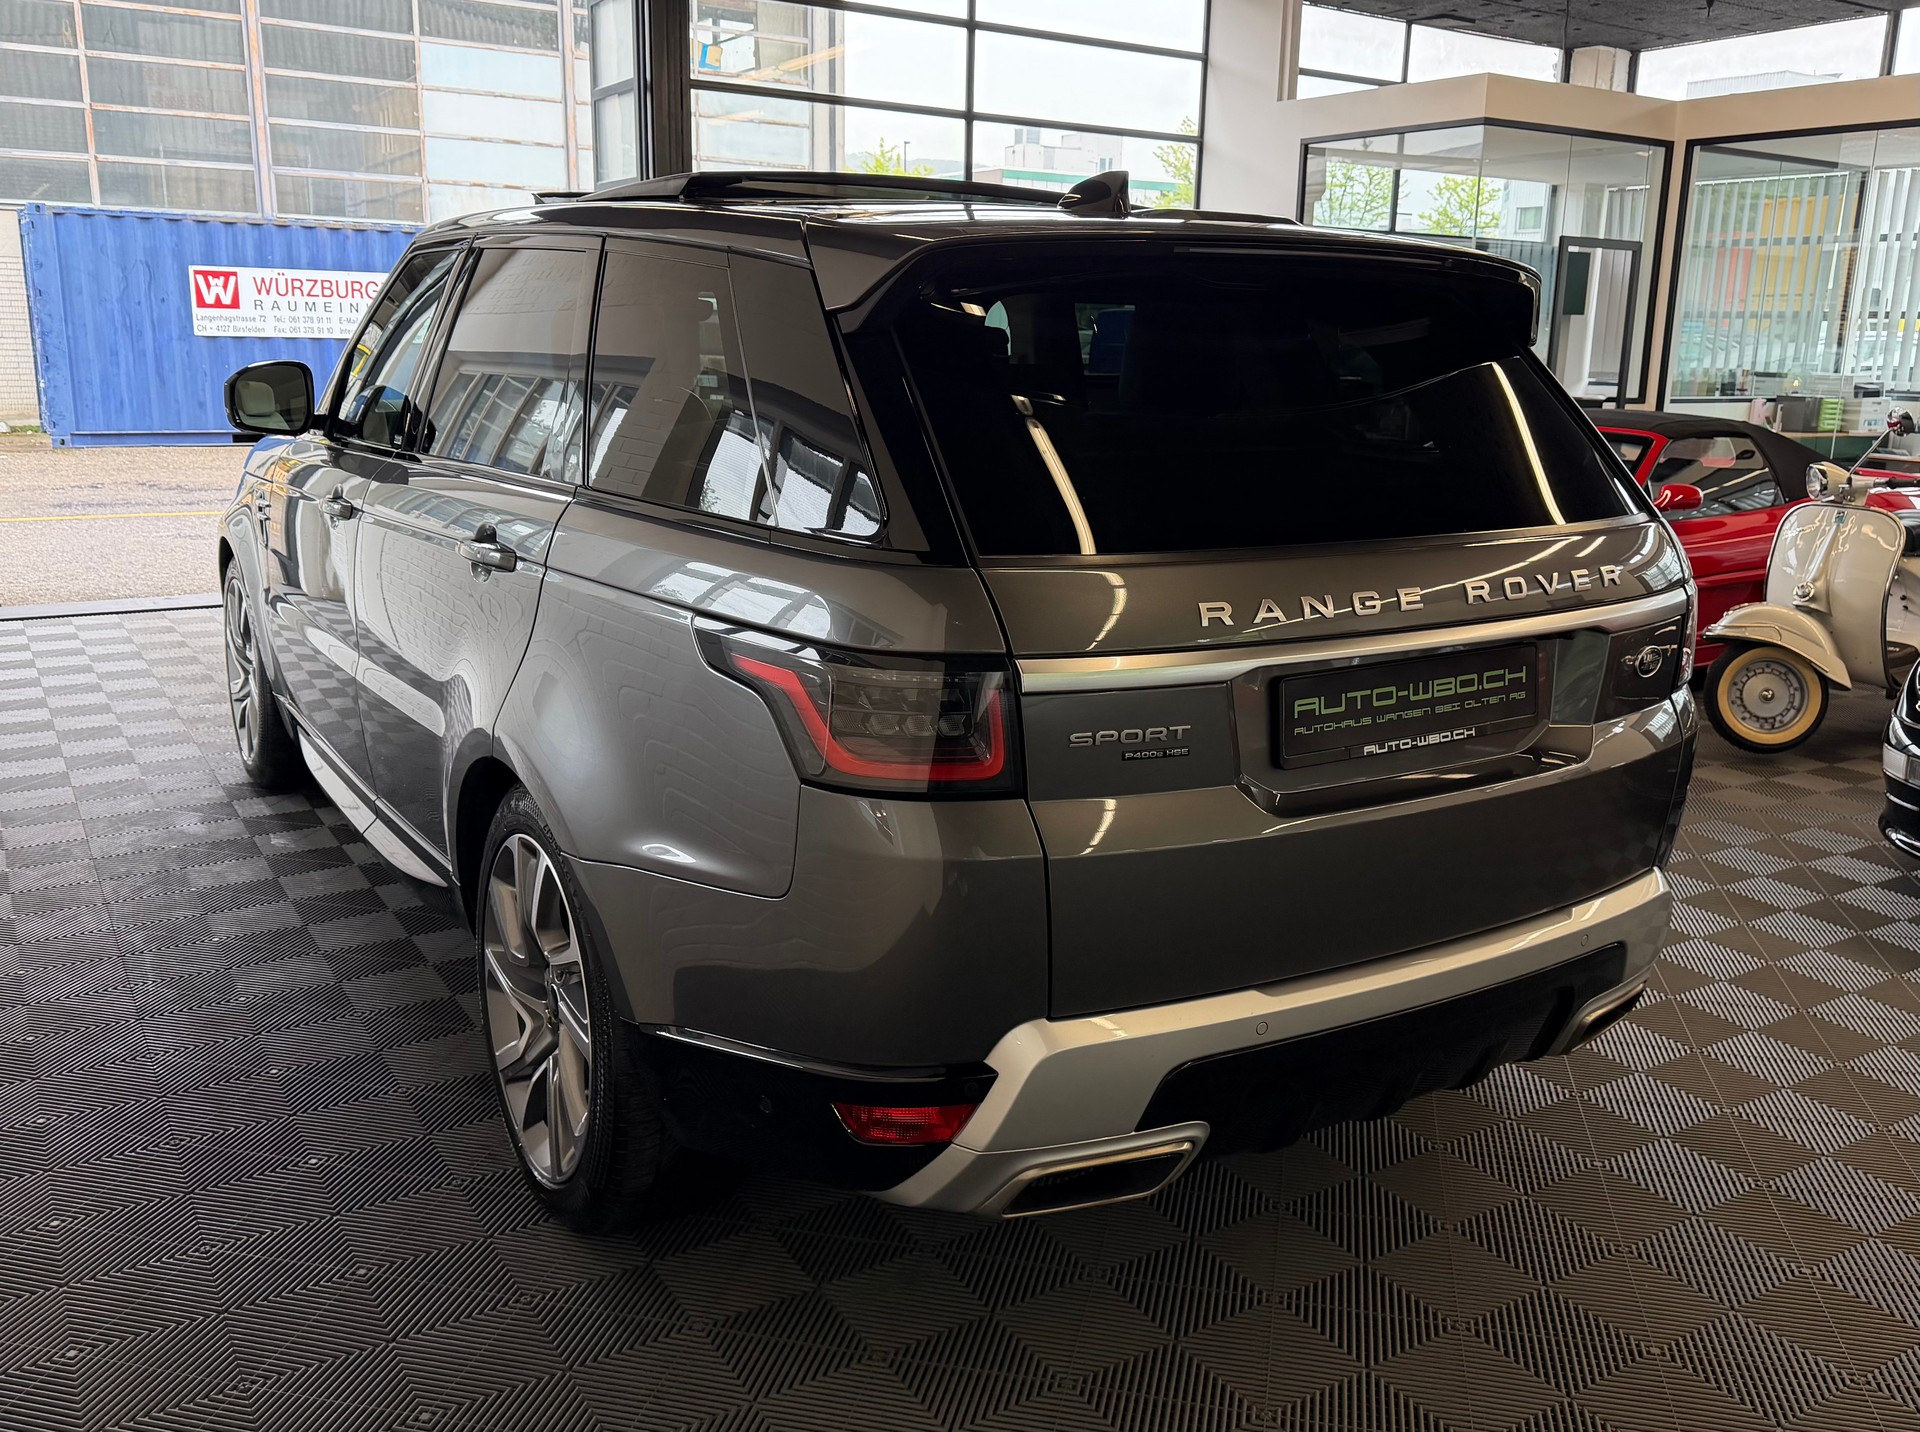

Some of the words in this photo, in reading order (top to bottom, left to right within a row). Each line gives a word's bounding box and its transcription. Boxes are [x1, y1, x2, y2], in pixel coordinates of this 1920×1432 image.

[252, 272, 385, 301] WÜRZBURG
[254, 299, 369, 314] RAUMEIN
[195, 314, 256, 323] Langenhagstrasse
[259, 315, 267, 323] 72
[302, 316, 314, 324] 378
[316, 316, 325, 324] 91
[197, 325, 207, 333] CH
[216, 325, 230, 333] 4127
[233, 325, 266, 333] Birsfelden
[289, 326, 300, 334] 061
[302, 326, 315, 334] 378
[317, 327, 325, 335] 91
[326, 327, 334, 335] 10
[1198, 585, 1425, 627] RANGE
[1464, 564, 1622, 604] ROVER
[1294, 665, 1527, 719] AUTO-WBO.CH
[1294, 716, 1372, 736] AUTOHAUS
[1376, 707, 1431, 723] WANGEN
[1435, 702, 1461, 714] BEI
[1464, 694, 1506, 709] OLTEN
[1509, 691, 1527, 701] AG
[1069, 725, 1192, 748] SPORT
[1363, 727, 1476, 756] AUTO-WBO.CH
[1125, 751, 1164, 760] P400e
[1166, 748, 1189, 756] HSE
